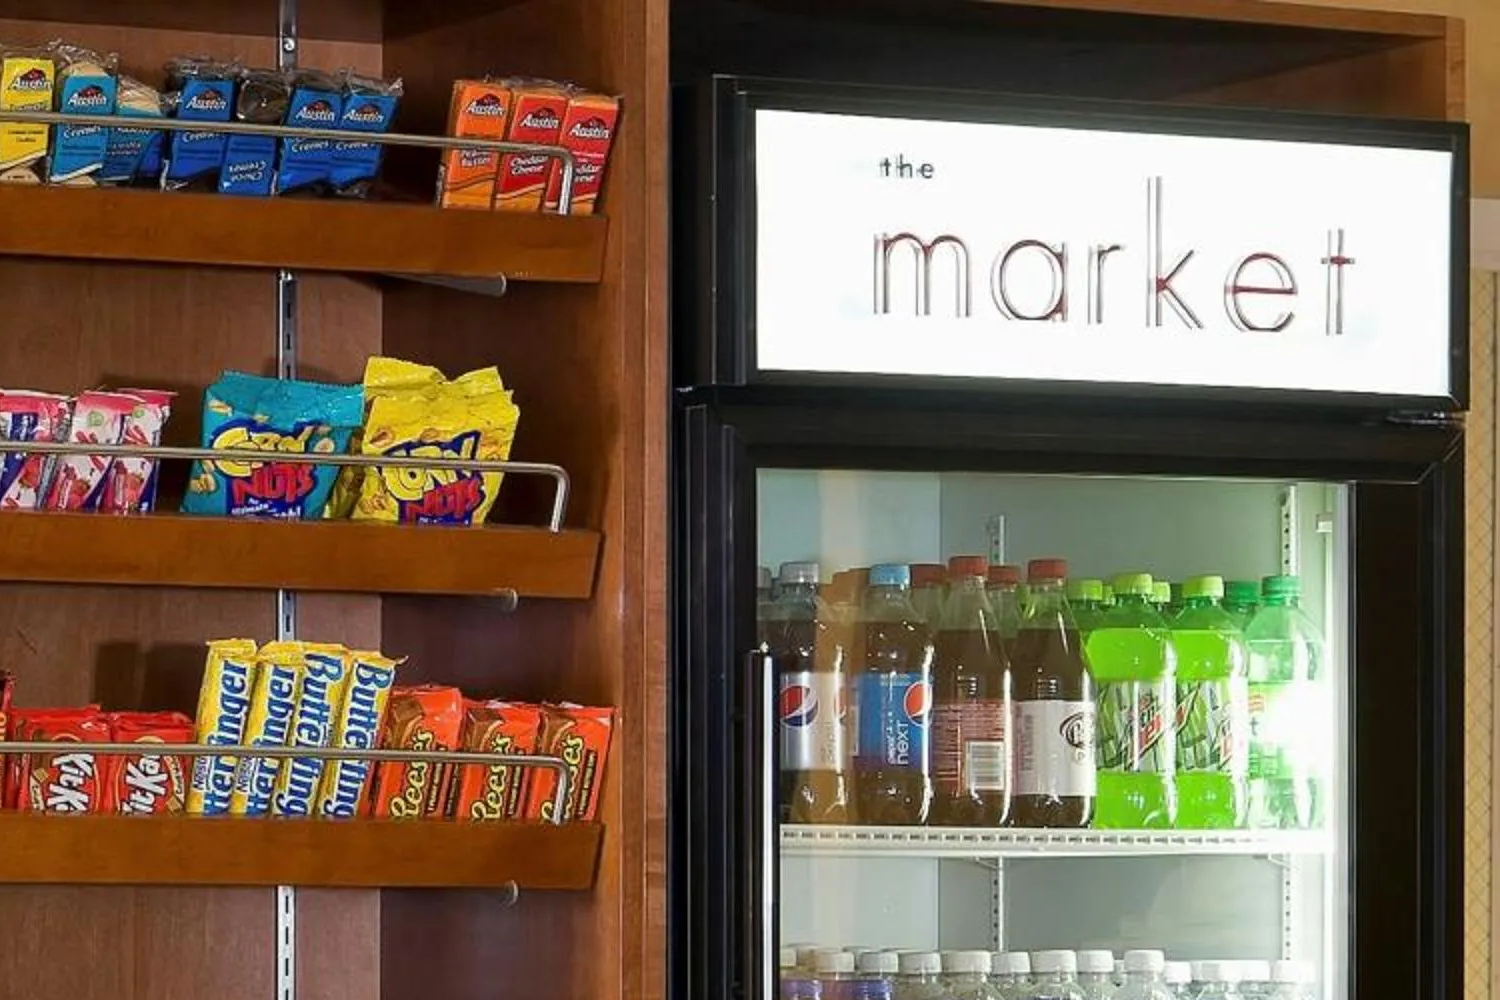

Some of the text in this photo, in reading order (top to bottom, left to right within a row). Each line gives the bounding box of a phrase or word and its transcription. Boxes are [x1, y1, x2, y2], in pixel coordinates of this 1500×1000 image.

[10, 78, 54, 91] Austin
[68, 92, 107, 106] Austin
[186, 94, 227, 112] Austin
[296, 106, 336, 122] Austin
[343, 108, 385, 124] Austin
[466, 100, 505, 117] Austin
[519, 114, 561, 130] Austin
[569, 123, 611, 140] Austin
[878, 154, 935, 181] the
[873, 176, 1355, 337] market
[231, 461, 317, 501] NUTS
[406, 479, 484, 518] NUTS
